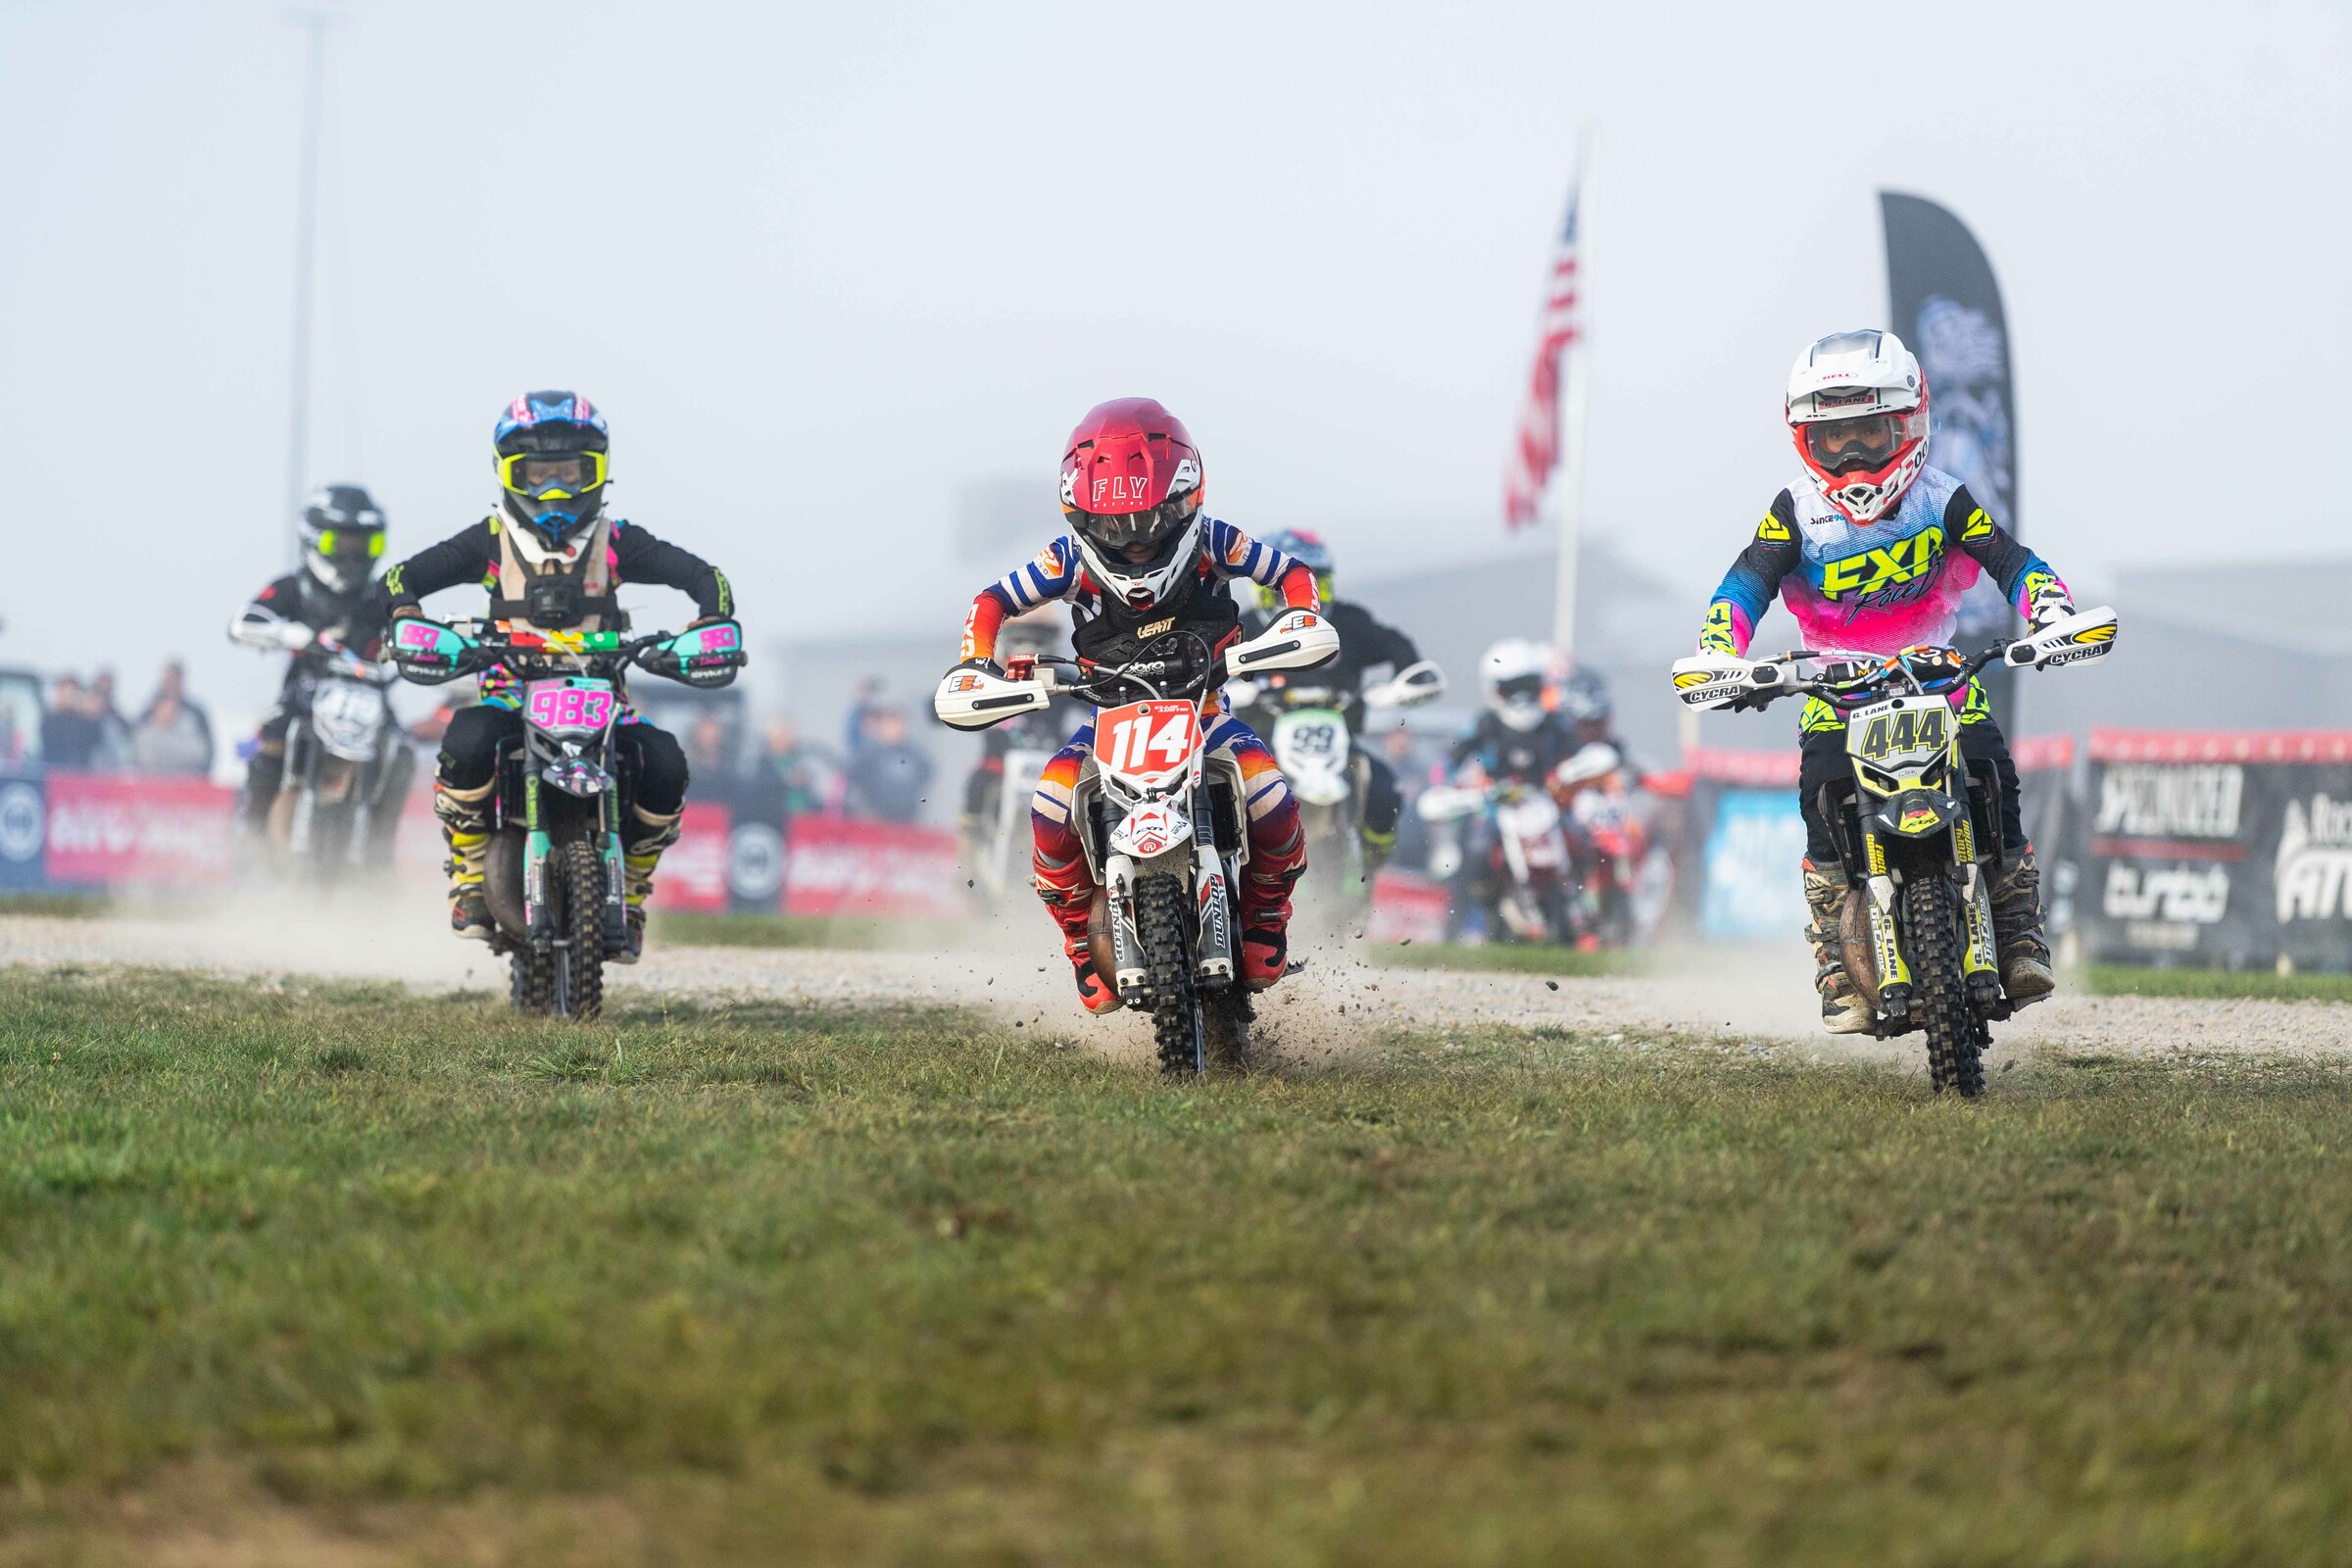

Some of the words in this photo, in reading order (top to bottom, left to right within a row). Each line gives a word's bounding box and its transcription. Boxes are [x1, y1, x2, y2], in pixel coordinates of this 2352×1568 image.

[1093, 476, 1148, 502] FLY
[2050, 645, 2103, 663] CYCRA
[530, 689, 612, 729] 983
[1690, 685, 1740, 702] CYCRA
[1865, 706, 1889, 716] LANE
[1110, 714, 1190, 771] 114
[1861, 708, 1947, 761] 444
[1956, 828, 1966, 862] ctory
[1209, 874, 1225, 949] DUNLOP
[1968, 903, 1980, 945] LANE
[1886, 939, 1898, 979] LANE
